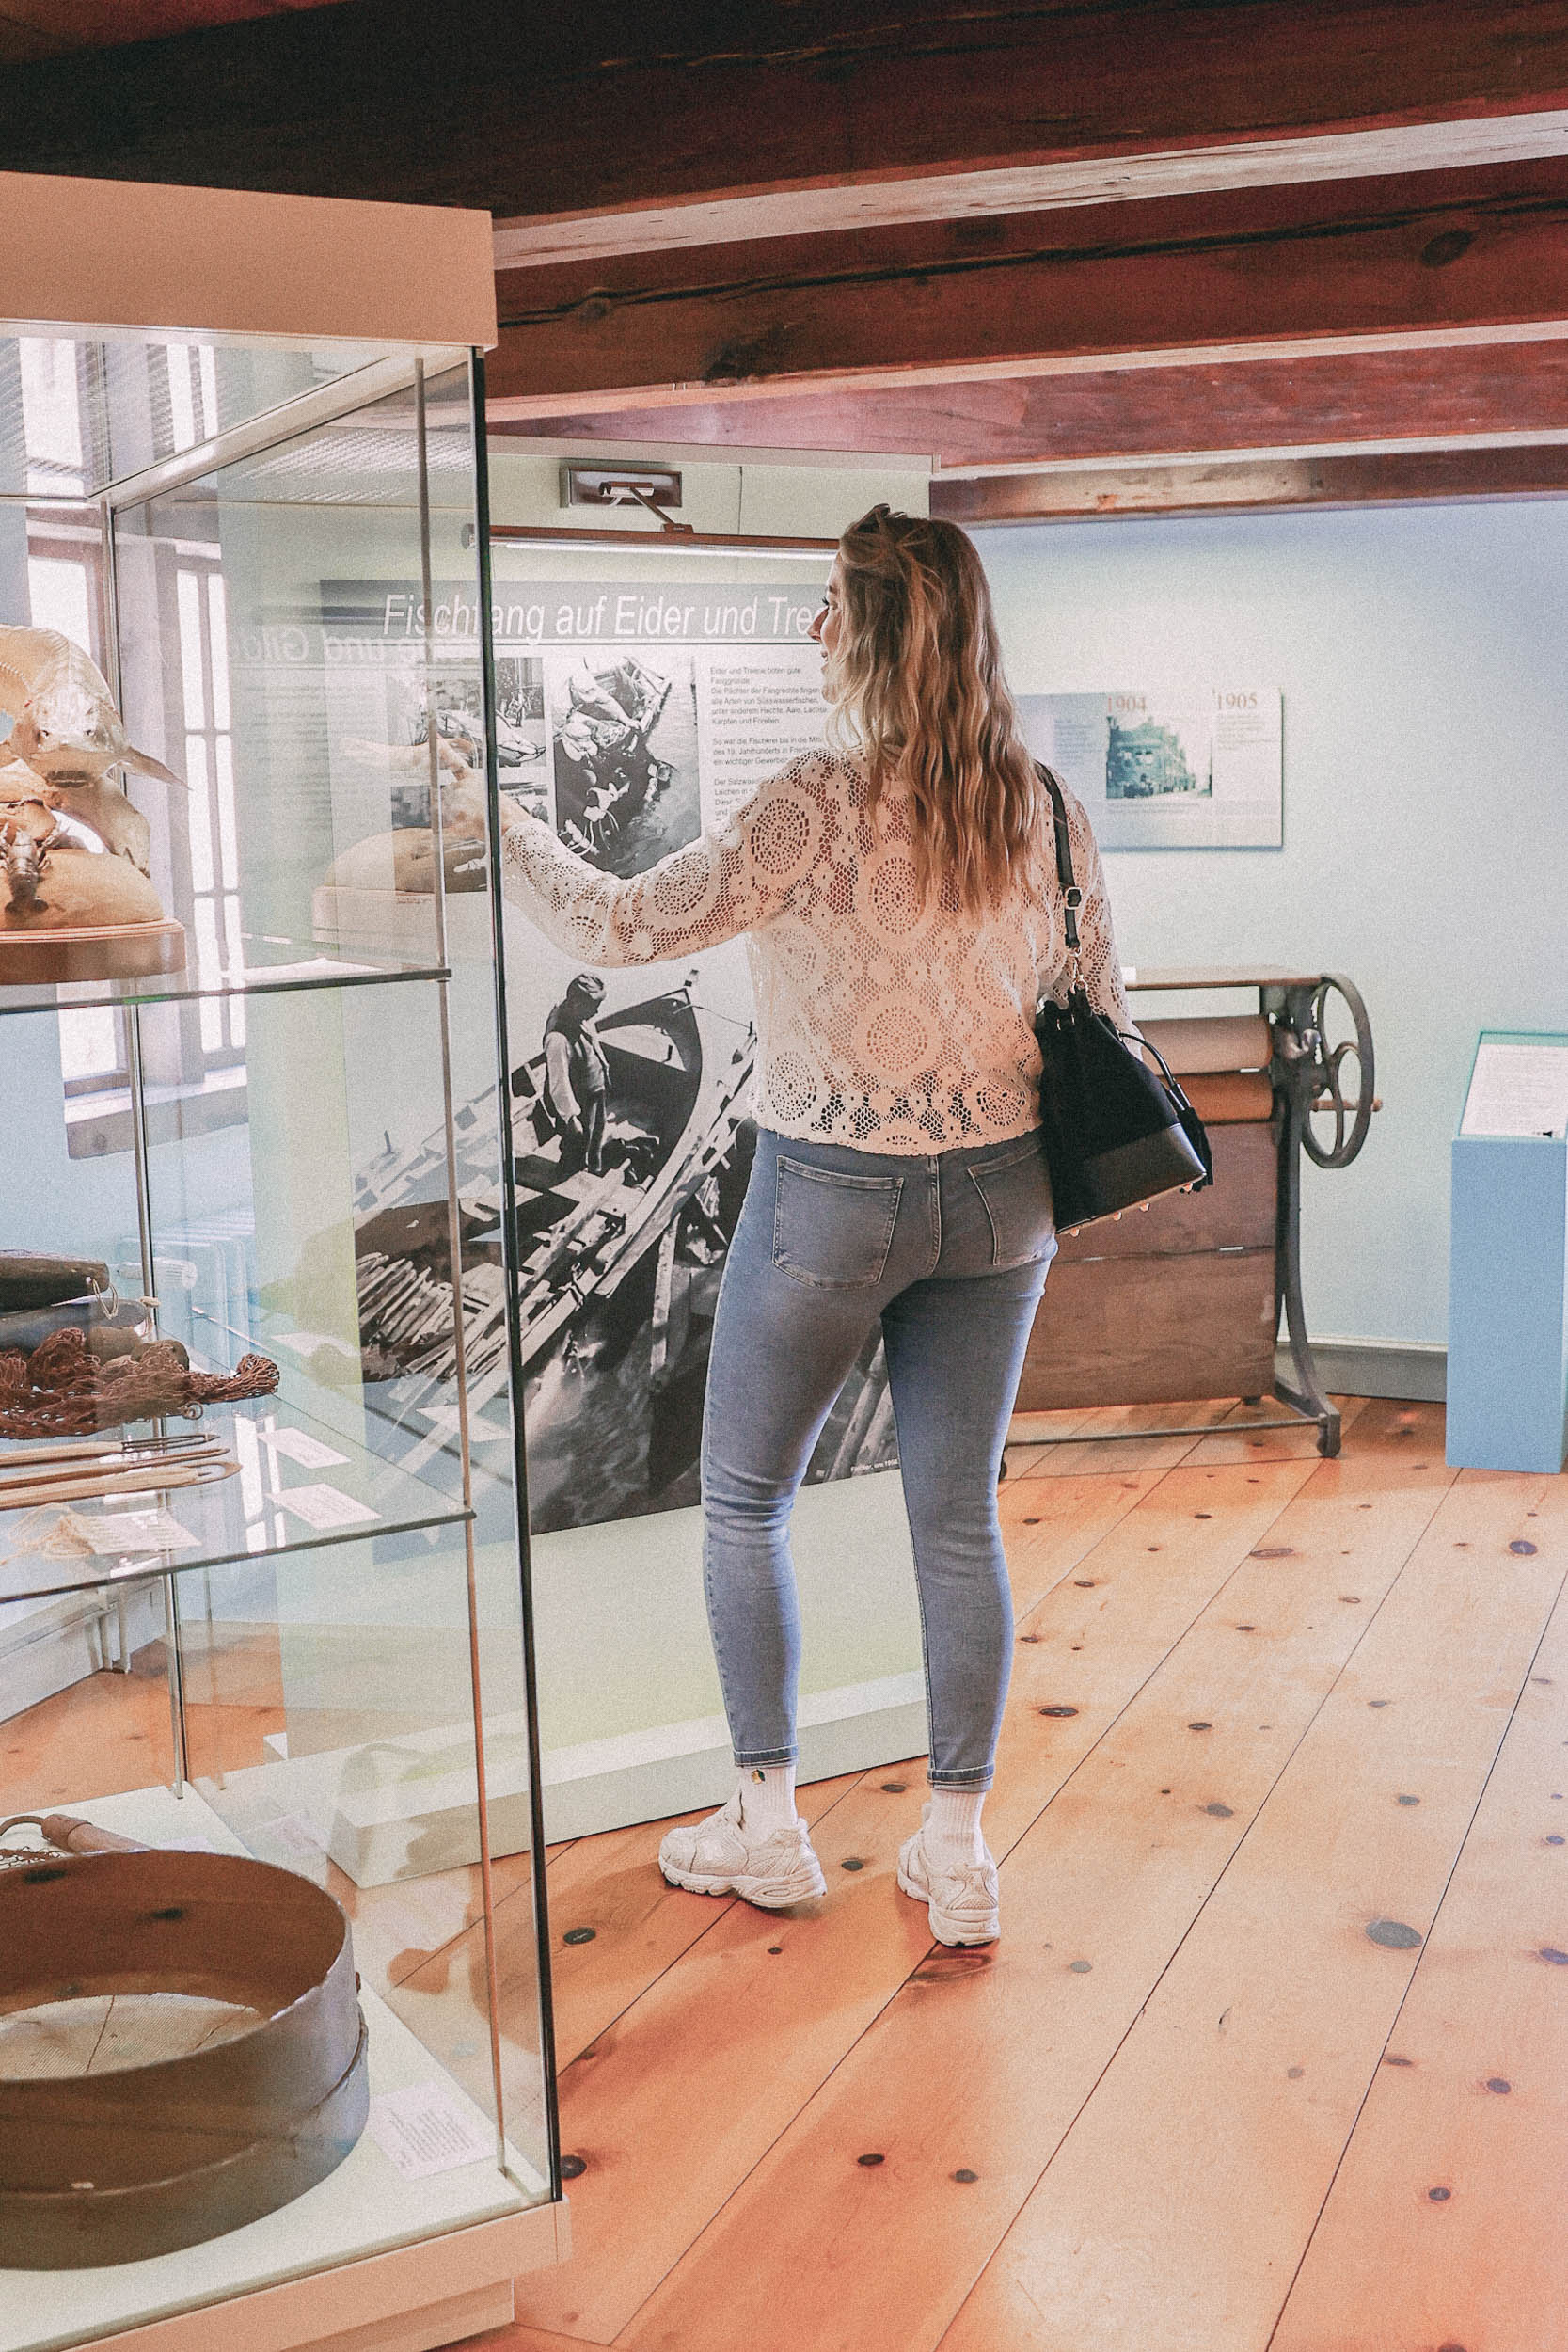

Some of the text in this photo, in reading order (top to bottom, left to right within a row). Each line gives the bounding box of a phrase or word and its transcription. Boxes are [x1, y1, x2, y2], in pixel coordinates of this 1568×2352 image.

[383, 594, 813, 645] Fischfang auf Eider und Tre
[743, 666, 766, 675] Treene
[787, 667, 801, 675] gute
[763, 686, 799, 696] Fangrechte
[800, 687, 820, 695] fingen
[1107, 695, 1147, 713] 1904
[1217, 692, 1258, 710] 1905
[712, 717, 737, 726] Karpfen
[739, 747, 780, 755] Jahrhunderts
[725, 758, 753, 767] wichtiger
